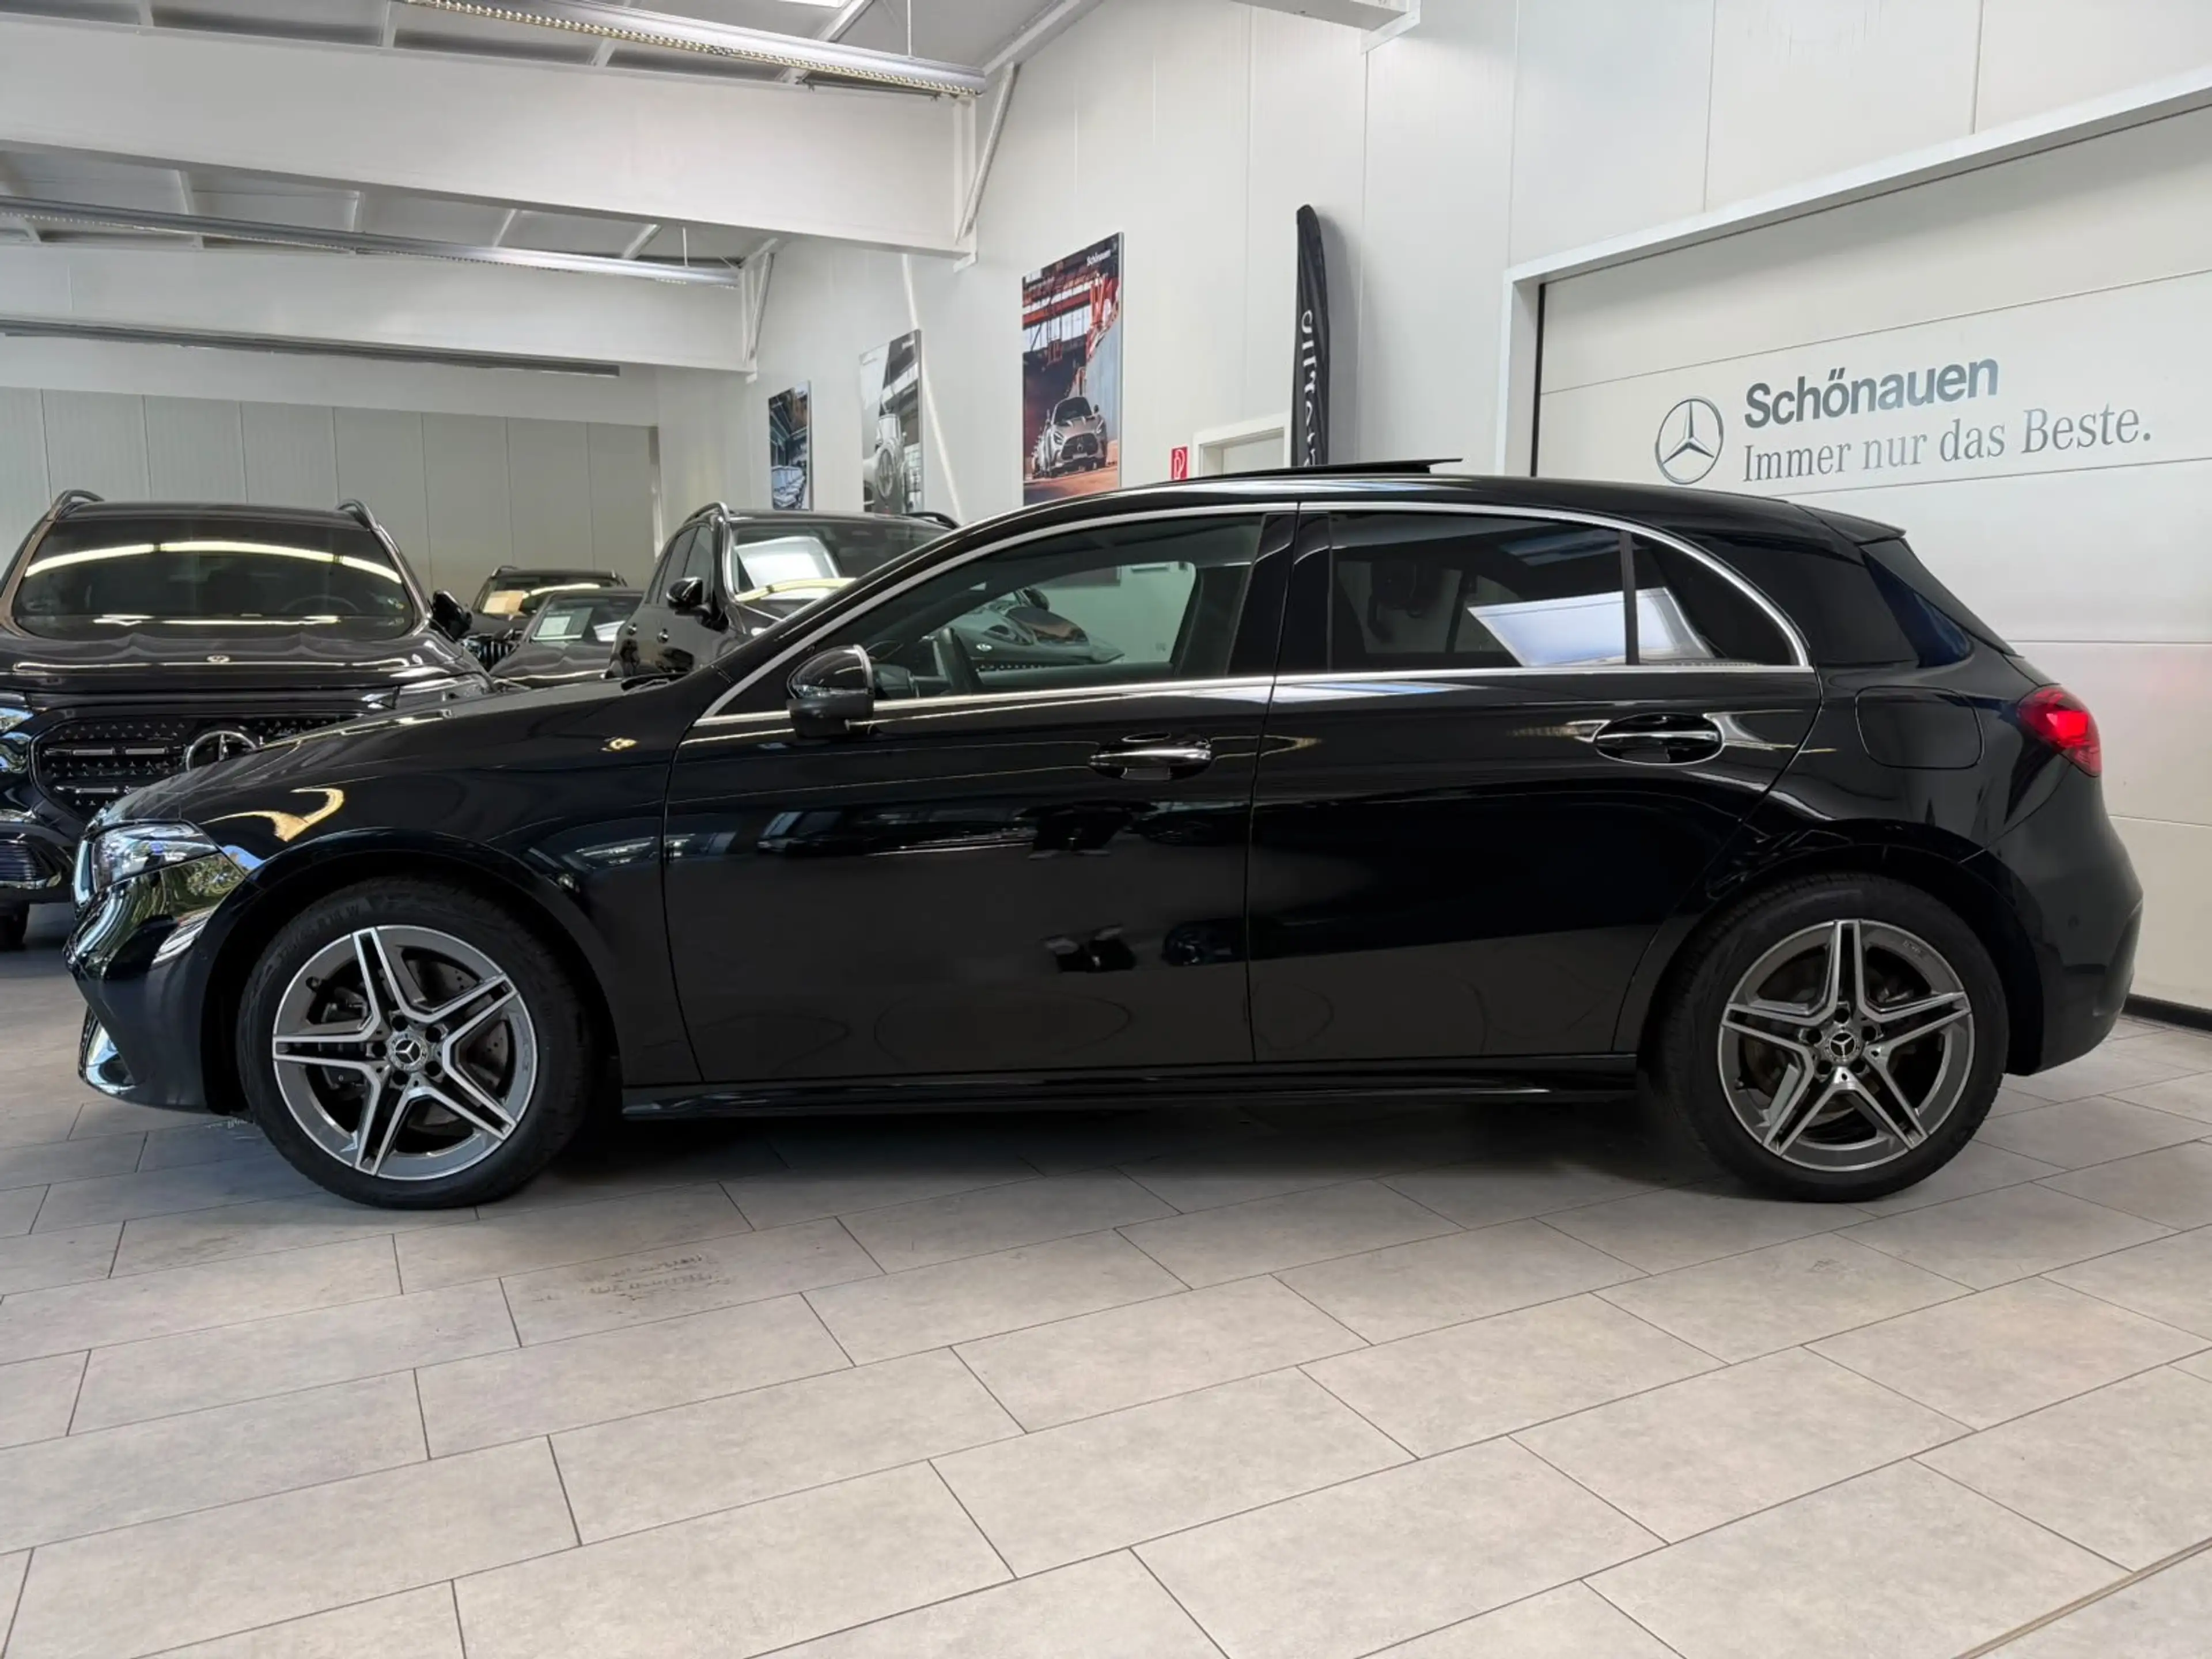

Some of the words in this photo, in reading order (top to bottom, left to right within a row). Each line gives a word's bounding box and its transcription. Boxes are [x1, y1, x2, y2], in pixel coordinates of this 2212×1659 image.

[1744, 358, 1999, 429] Schönauen
[1742, 442, 1852, 482] Immer
[1862, 434, 1928, 471] nur
[1939, 418, 2005, 463] das
[2020, 403, 2152, 454] Beste.
